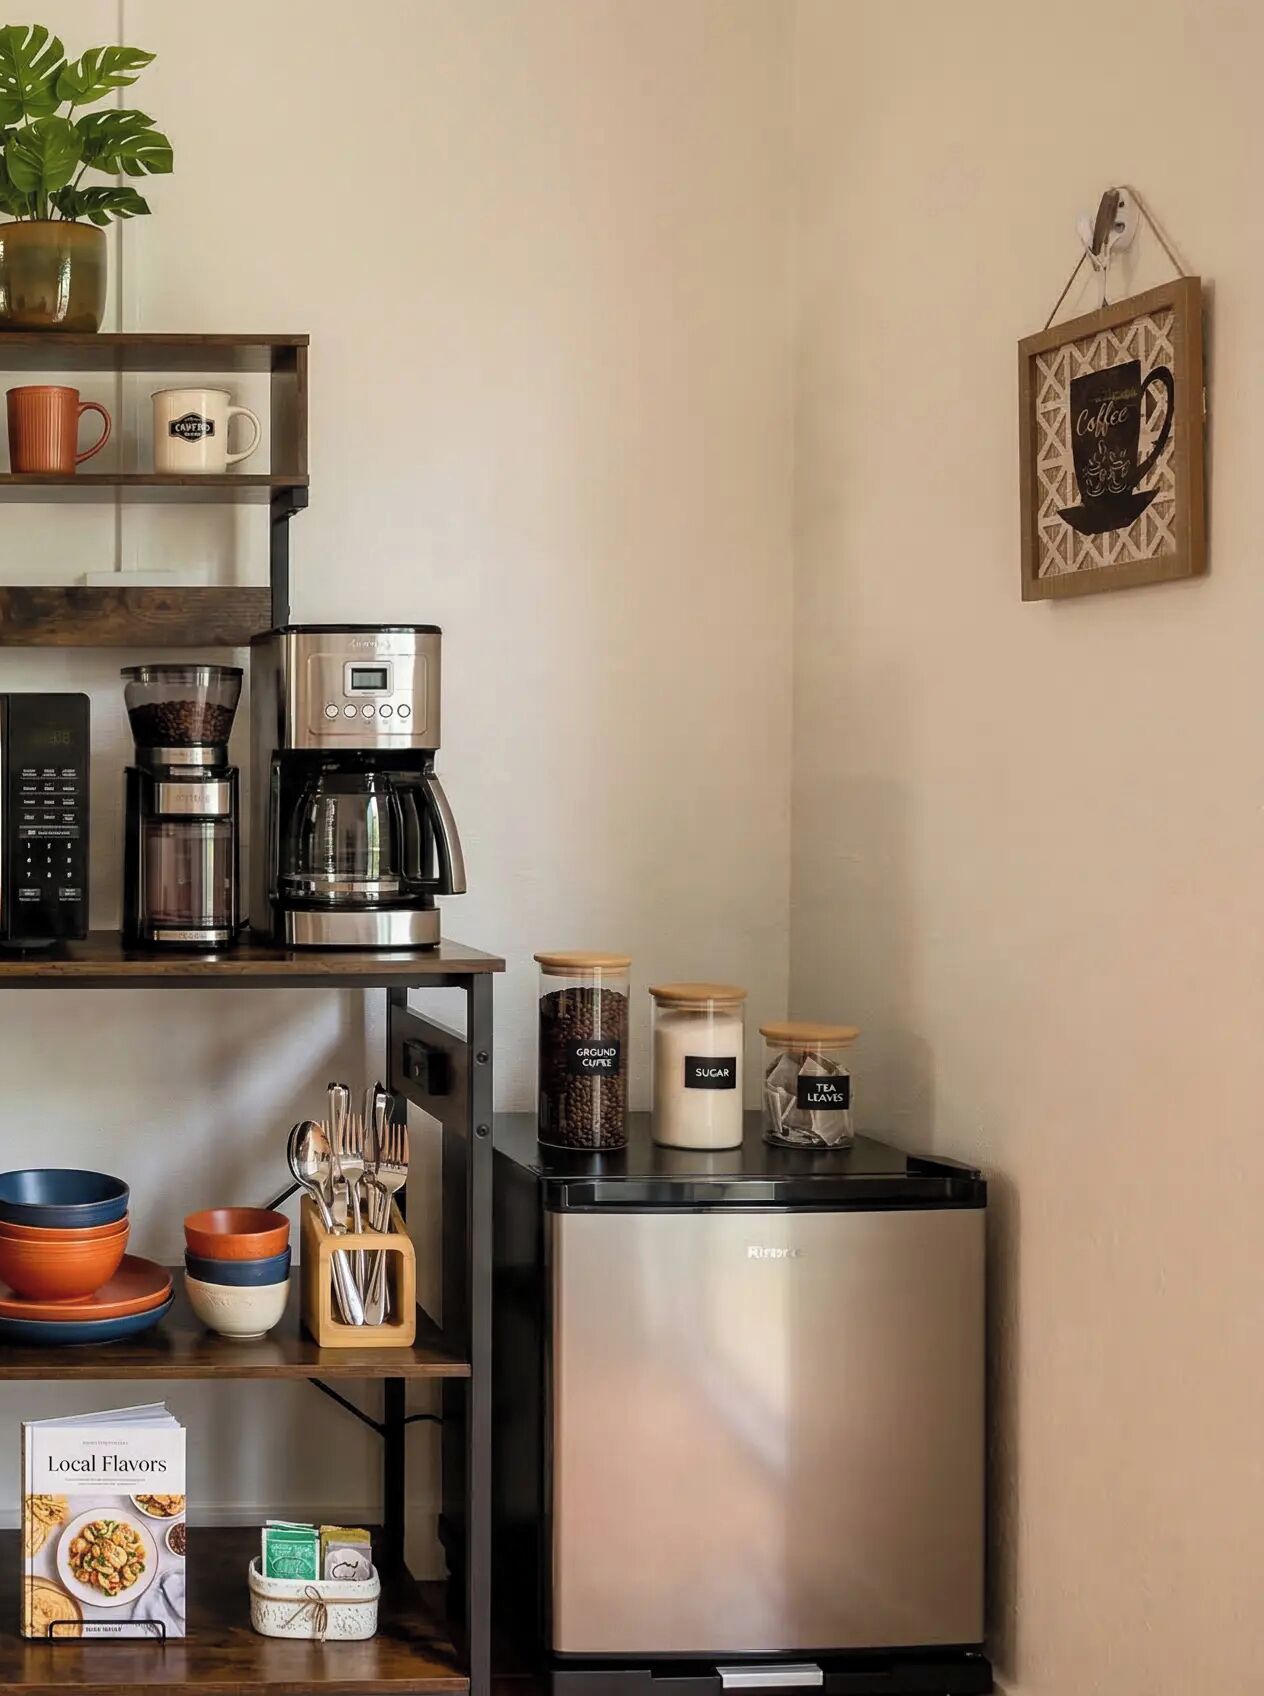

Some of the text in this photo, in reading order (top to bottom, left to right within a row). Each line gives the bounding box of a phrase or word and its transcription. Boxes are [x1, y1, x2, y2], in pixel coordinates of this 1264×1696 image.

[1076, 400, 1128, 438] Coffee
[695, 1068, 730, 1078] SUGAR
[815, 1083, 837, 1092] TEA
[48, 1454, 167, 1472] Local Flavors
